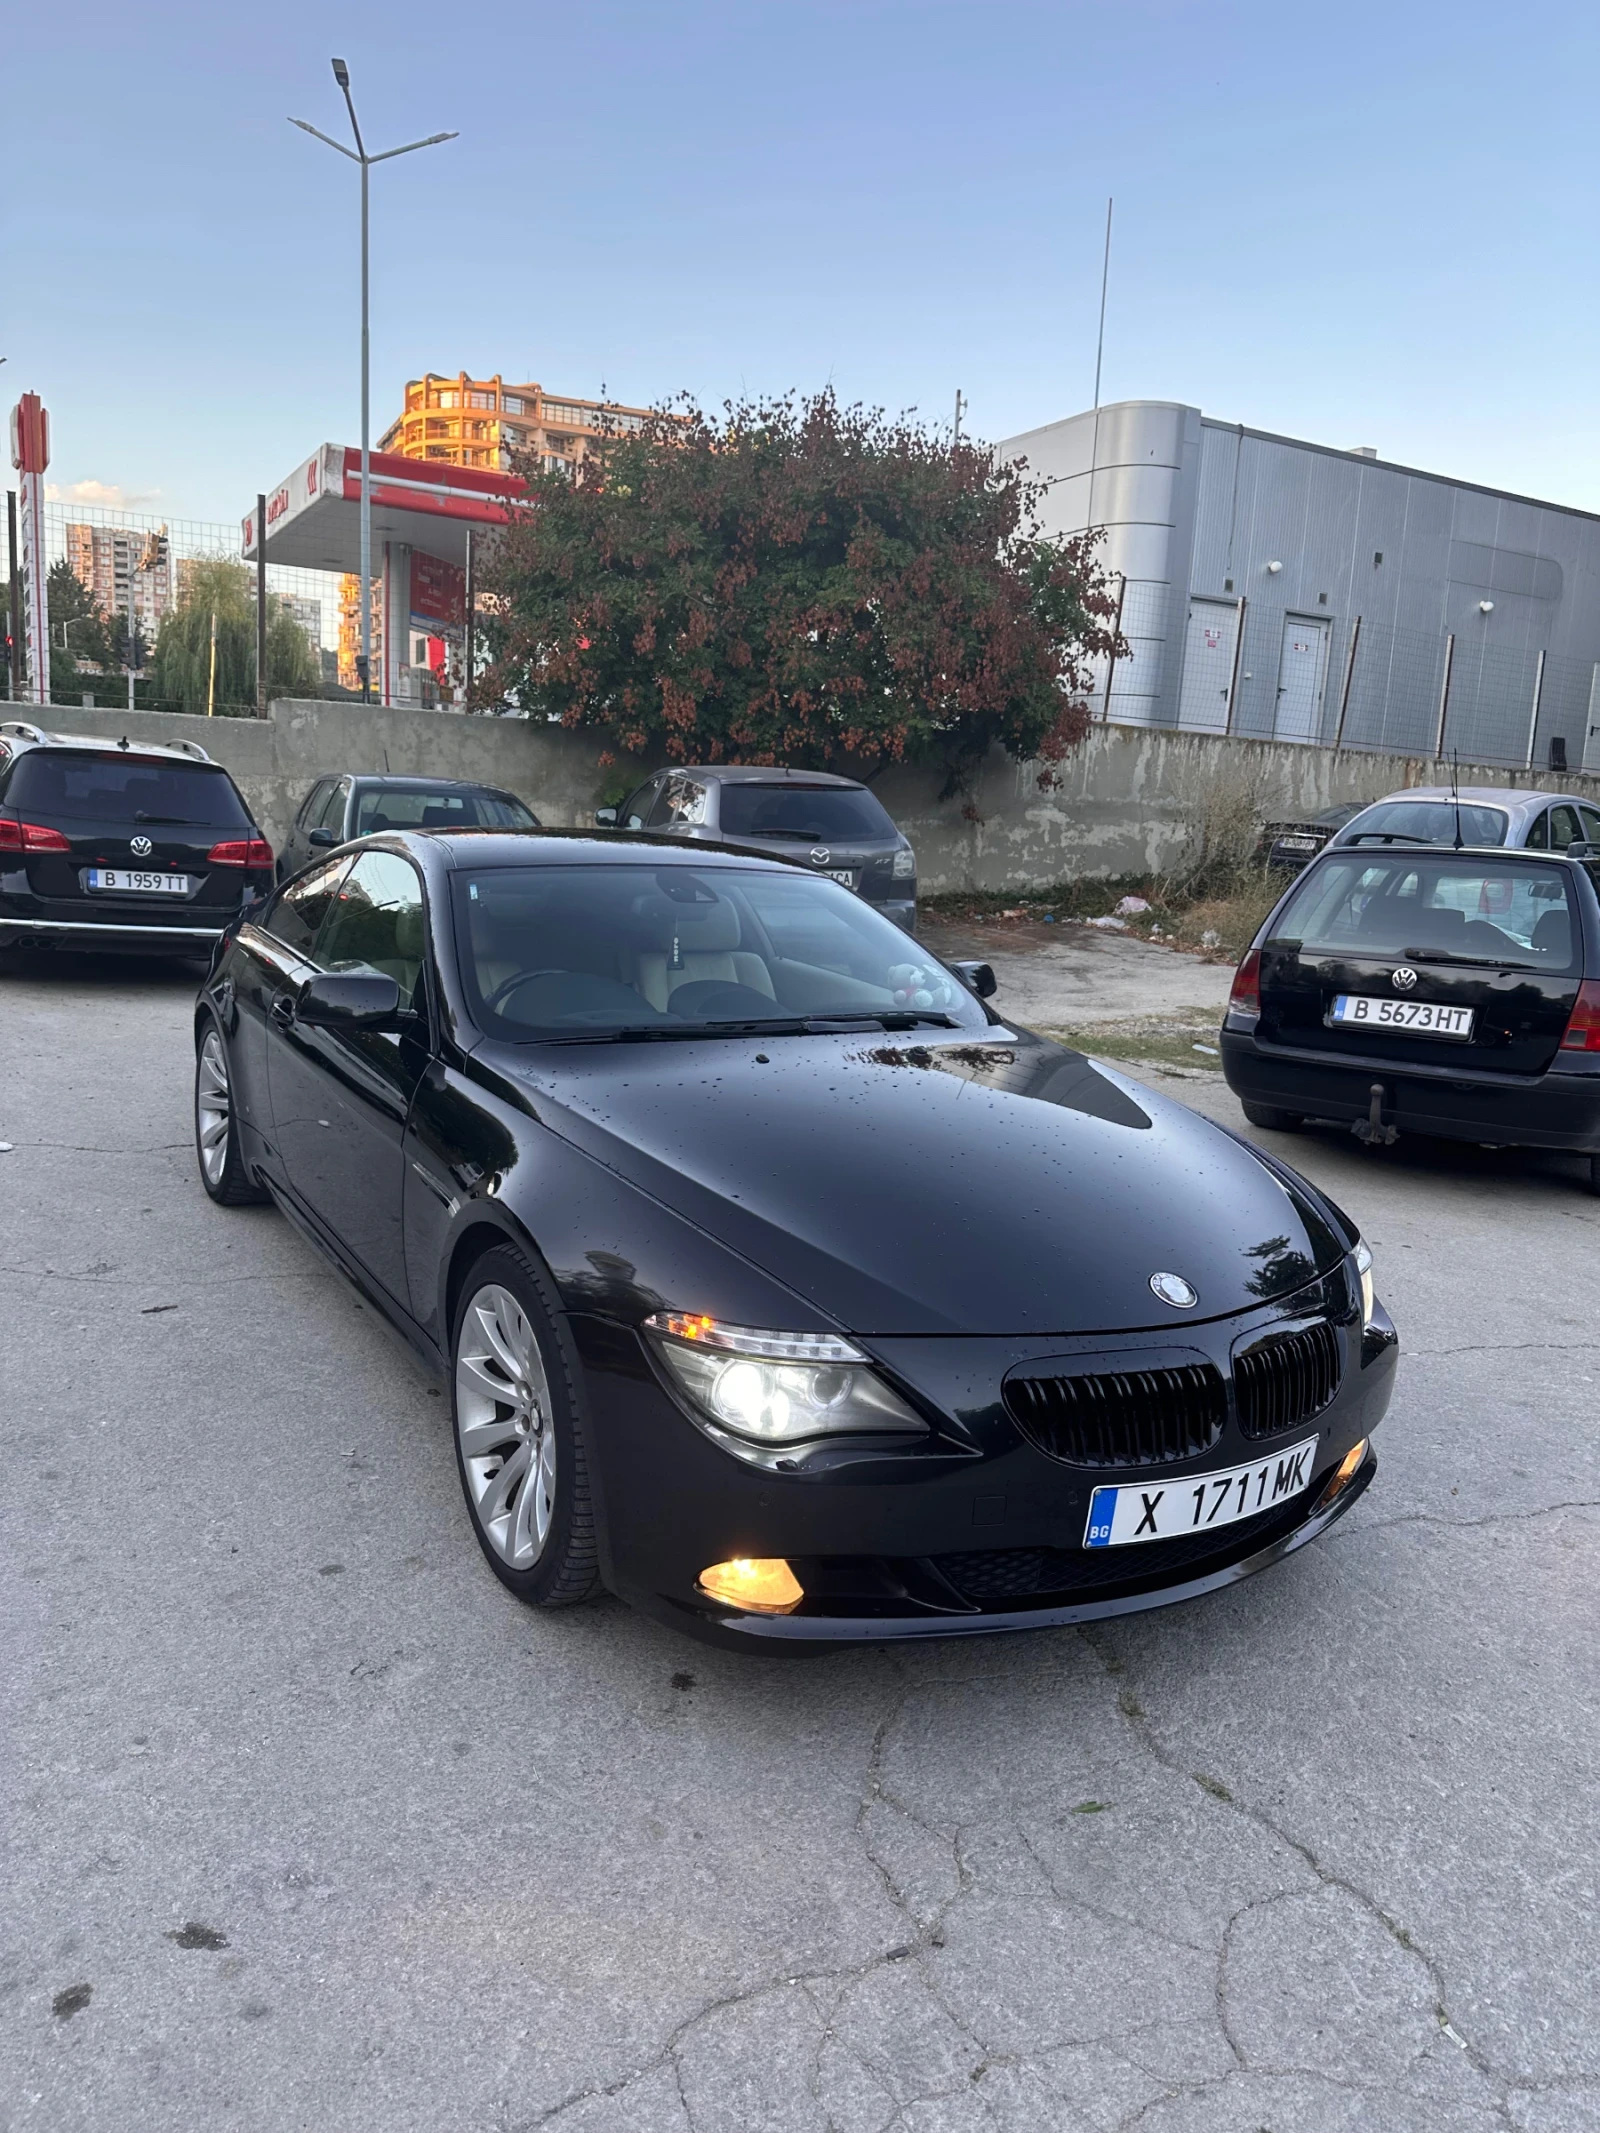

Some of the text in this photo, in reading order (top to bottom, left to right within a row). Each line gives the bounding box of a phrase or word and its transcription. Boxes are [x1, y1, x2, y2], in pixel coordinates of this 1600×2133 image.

[105, 872, 116, 887] B
[1353, 1000, 1369, 1020] B
[1134, 1490, 1165, 1536] X
[1089, 1525, 1110, 1539] BG
